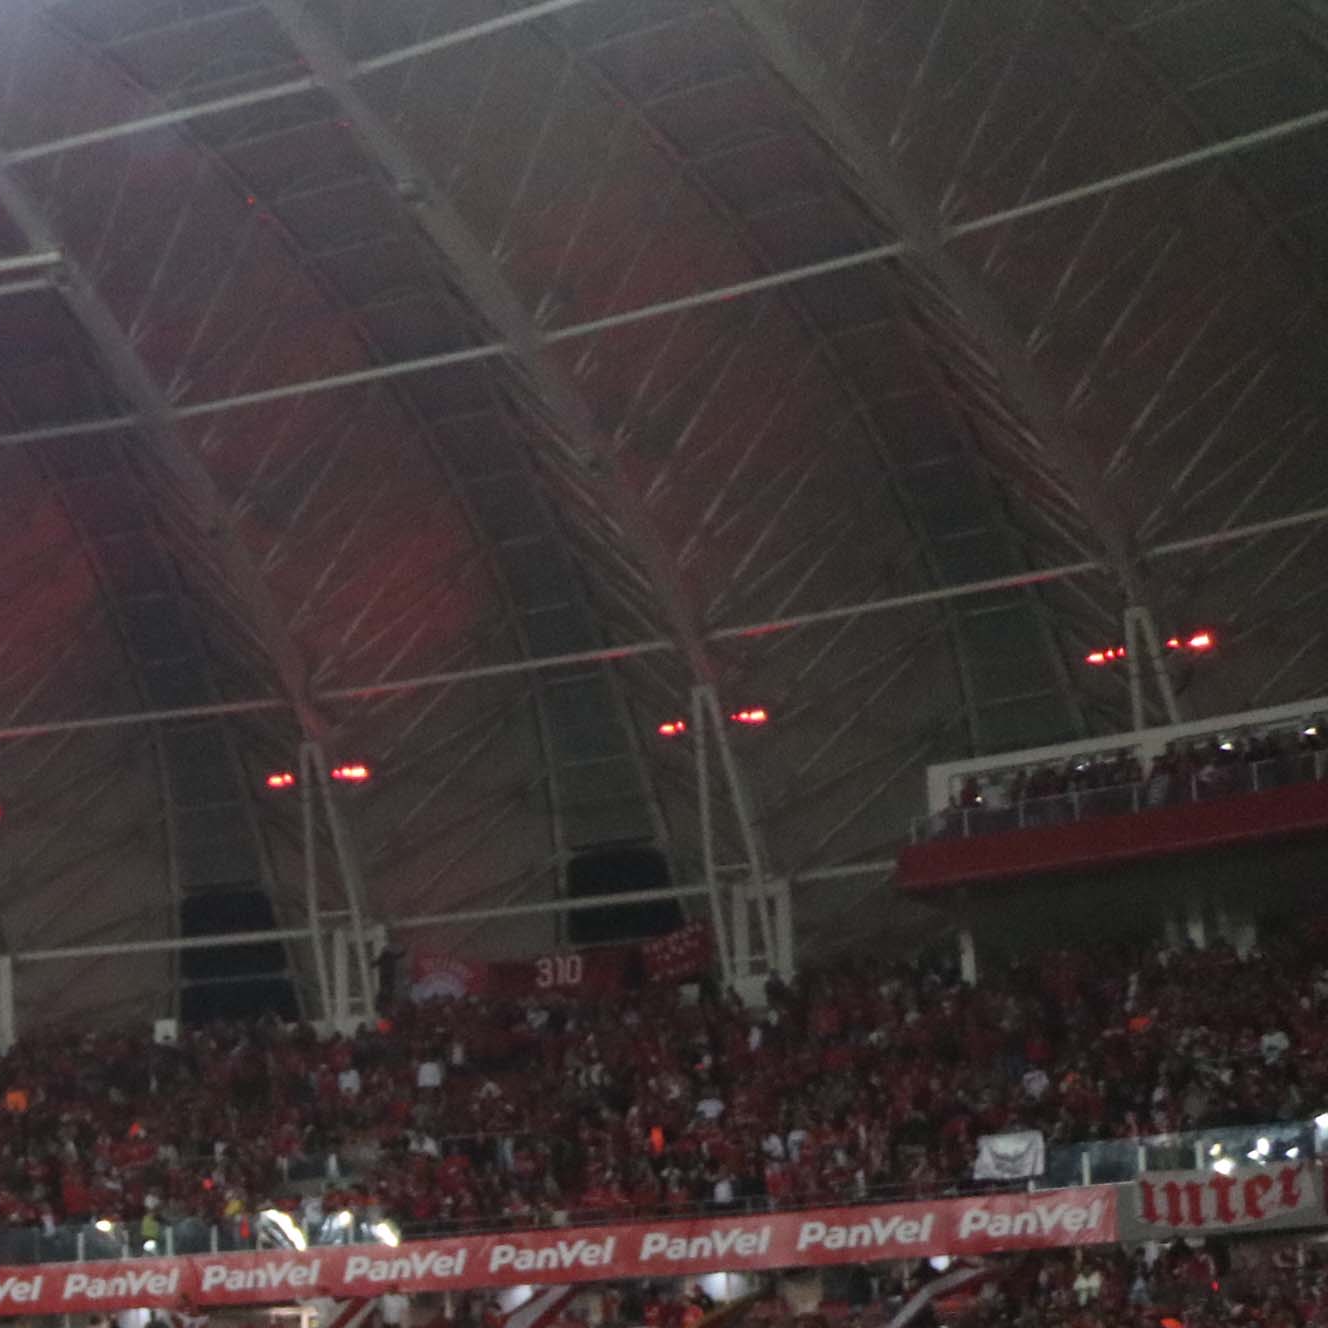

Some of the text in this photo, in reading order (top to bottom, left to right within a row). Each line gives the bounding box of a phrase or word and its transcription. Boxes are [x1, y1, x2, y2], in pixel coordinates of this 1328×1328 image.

[535, 955, 583, 987] 310
[63, 1269, 181, 1300] PanVel
[202, 1259, 321, 1291] PanVel
[345, 1247, 468, 1283] PanVel
[490, 1236, 614, 1274] PanVel
[640, 1225, 771, 1261] PanVel
[796, 1213, 935, 1251] PanVel
[958, 1197, 1103, 1240] PanVel
